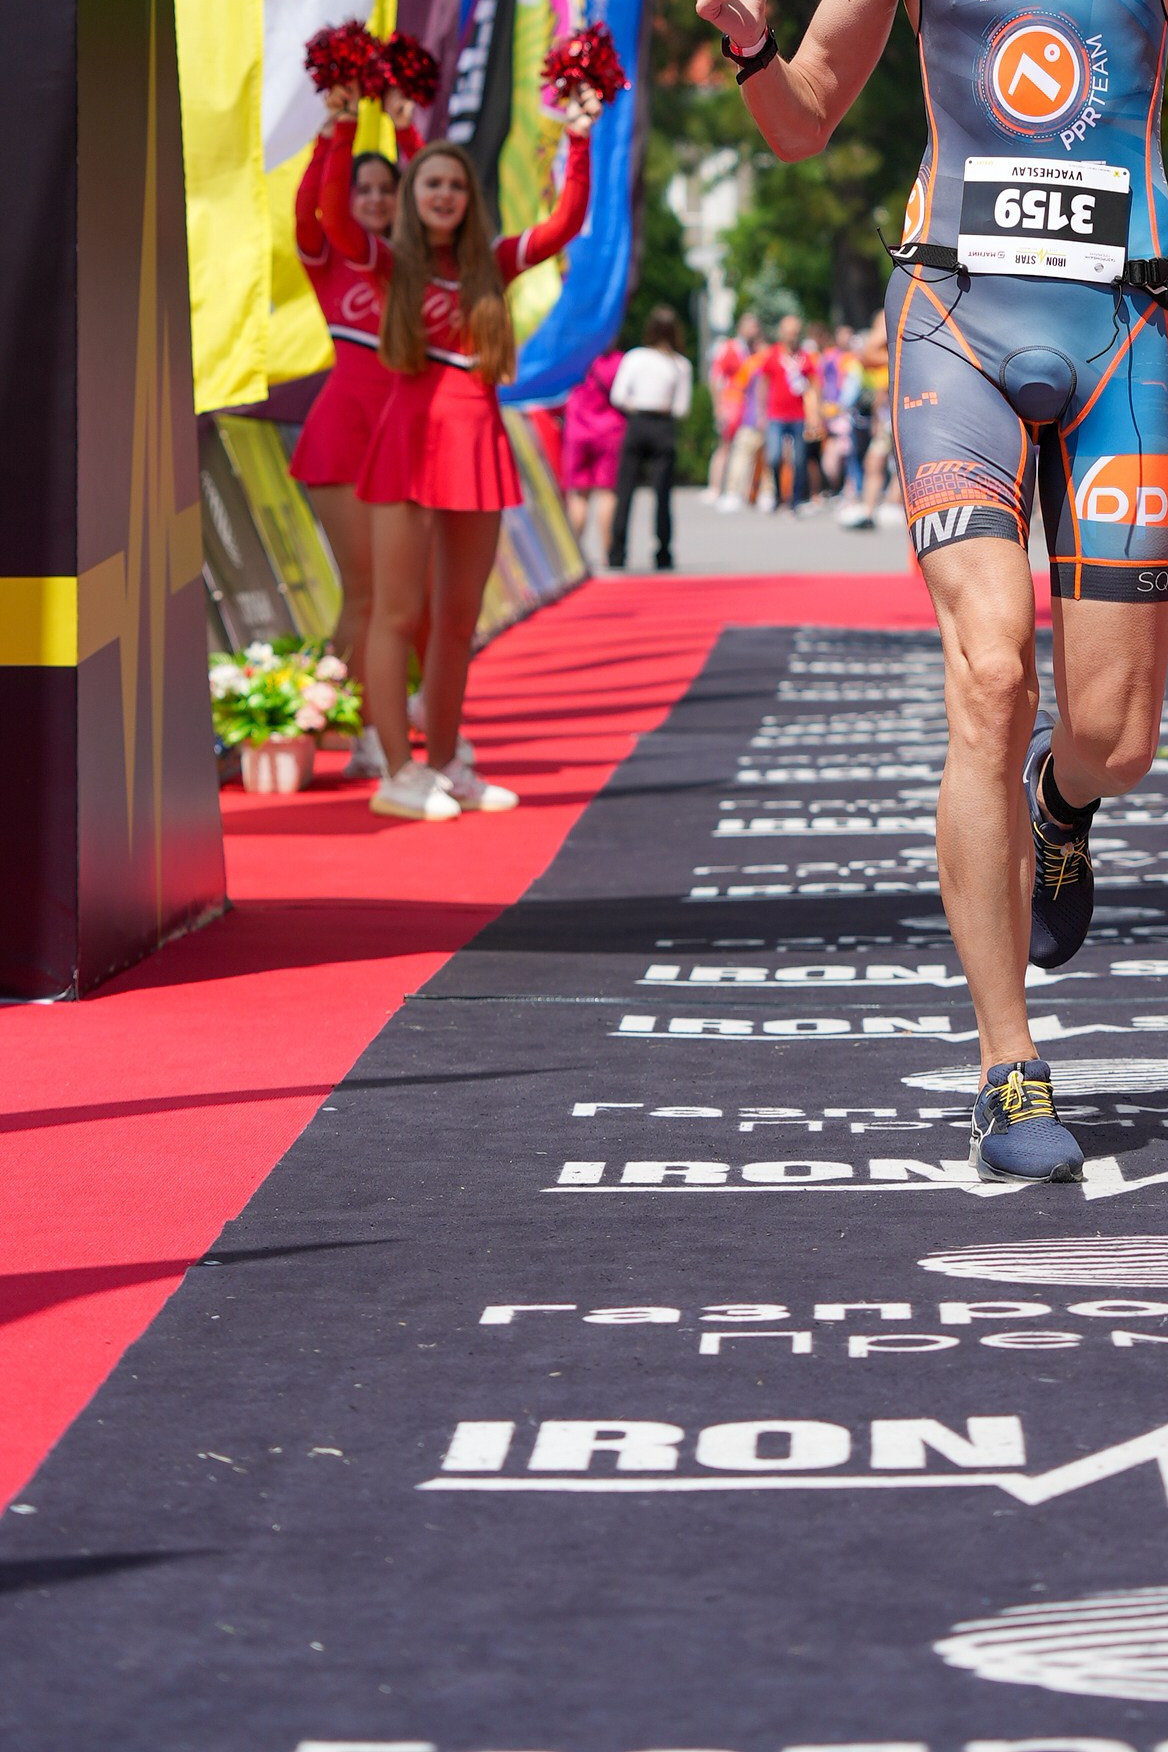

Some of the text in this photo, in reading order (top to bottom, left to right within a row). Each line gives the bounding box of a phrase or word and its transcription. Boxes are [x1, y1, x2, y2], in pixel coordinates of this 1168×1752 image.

[1011, 166, 1084, 181] VYACHESLAV
[993, 188, 1096, 234] 3159
[1015, 254, 1067, 268] IRON STAR
[644, 964, 947, 981] IRON
[619, 1014, 952, 1034] IRON
[557, 1159, 984, 1185] IRON
[444, 1416, 1027, 1473] IRON
